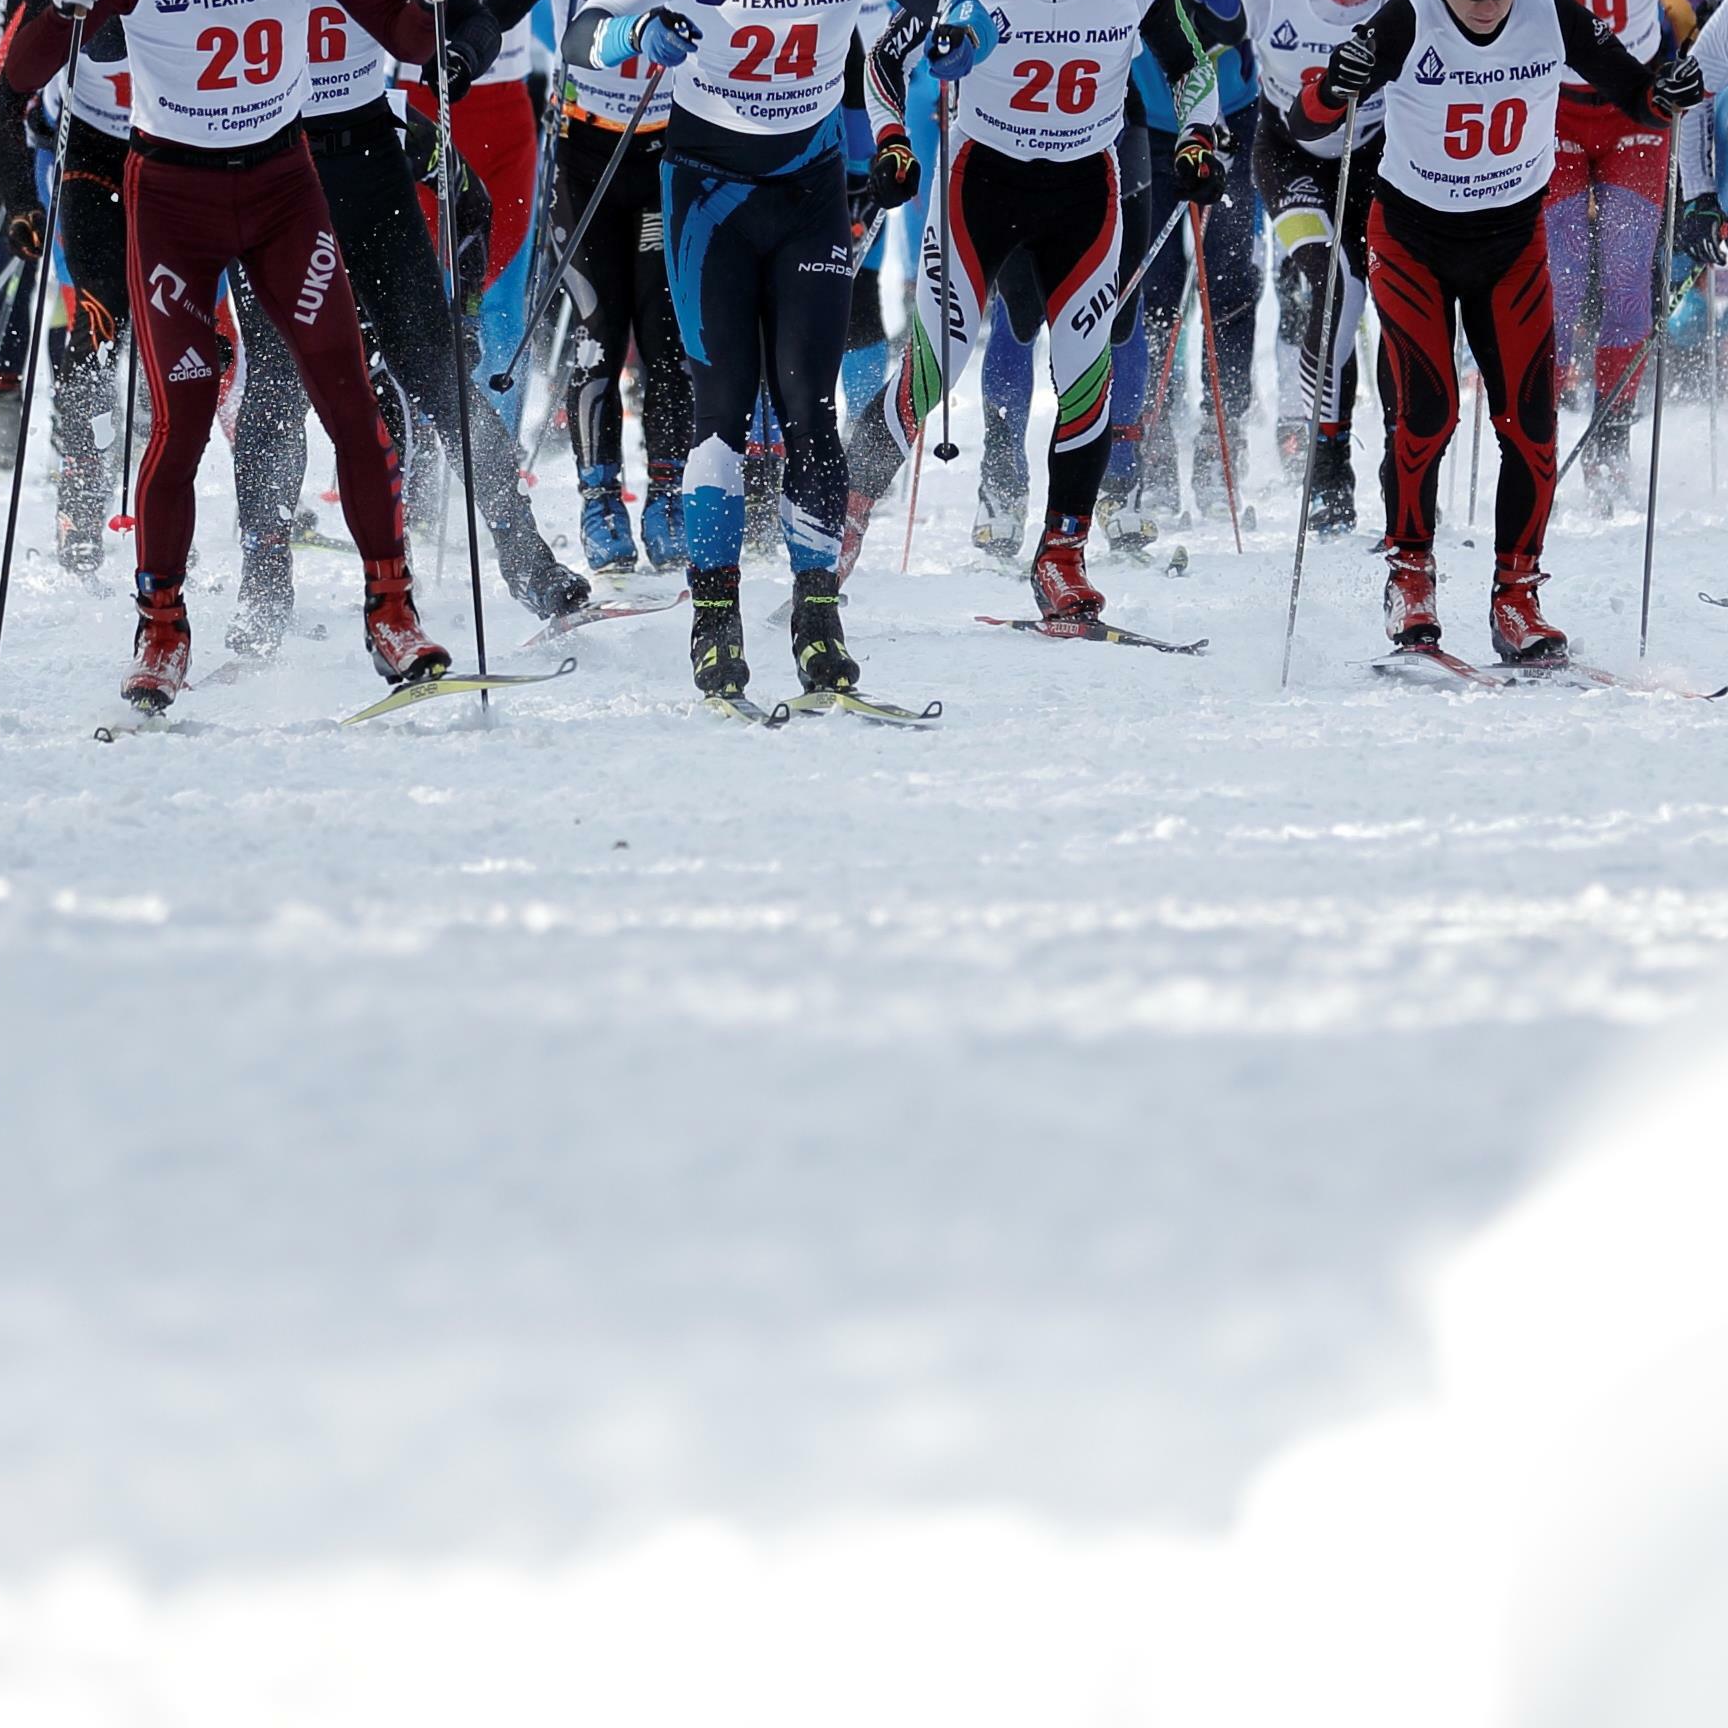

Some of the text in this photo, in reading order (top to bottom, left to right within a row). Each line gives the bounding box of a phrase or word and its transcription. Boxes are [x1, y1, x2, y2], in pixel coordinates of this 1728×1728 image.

[196, 18, 284, 92] 29
[728, 23, 819, 83] 24
[766, 84, 823, 102] лыжного
[1008, 58, 1102, 115] 26
[158, 92, 285, 118] Федерация лыжного
[207, 104, 283, 132] г. Серпухова
[736, 101, 819, 121] г. Серпухова
[1040, 123, 1095, 138] лыжного
[1444, 97, 1529, 161] 50
[1028, 135, 1092, 152] Серпухова
[293, 230, 337, 326] LUKOIL
[168, 364, 213, 382] adidas
